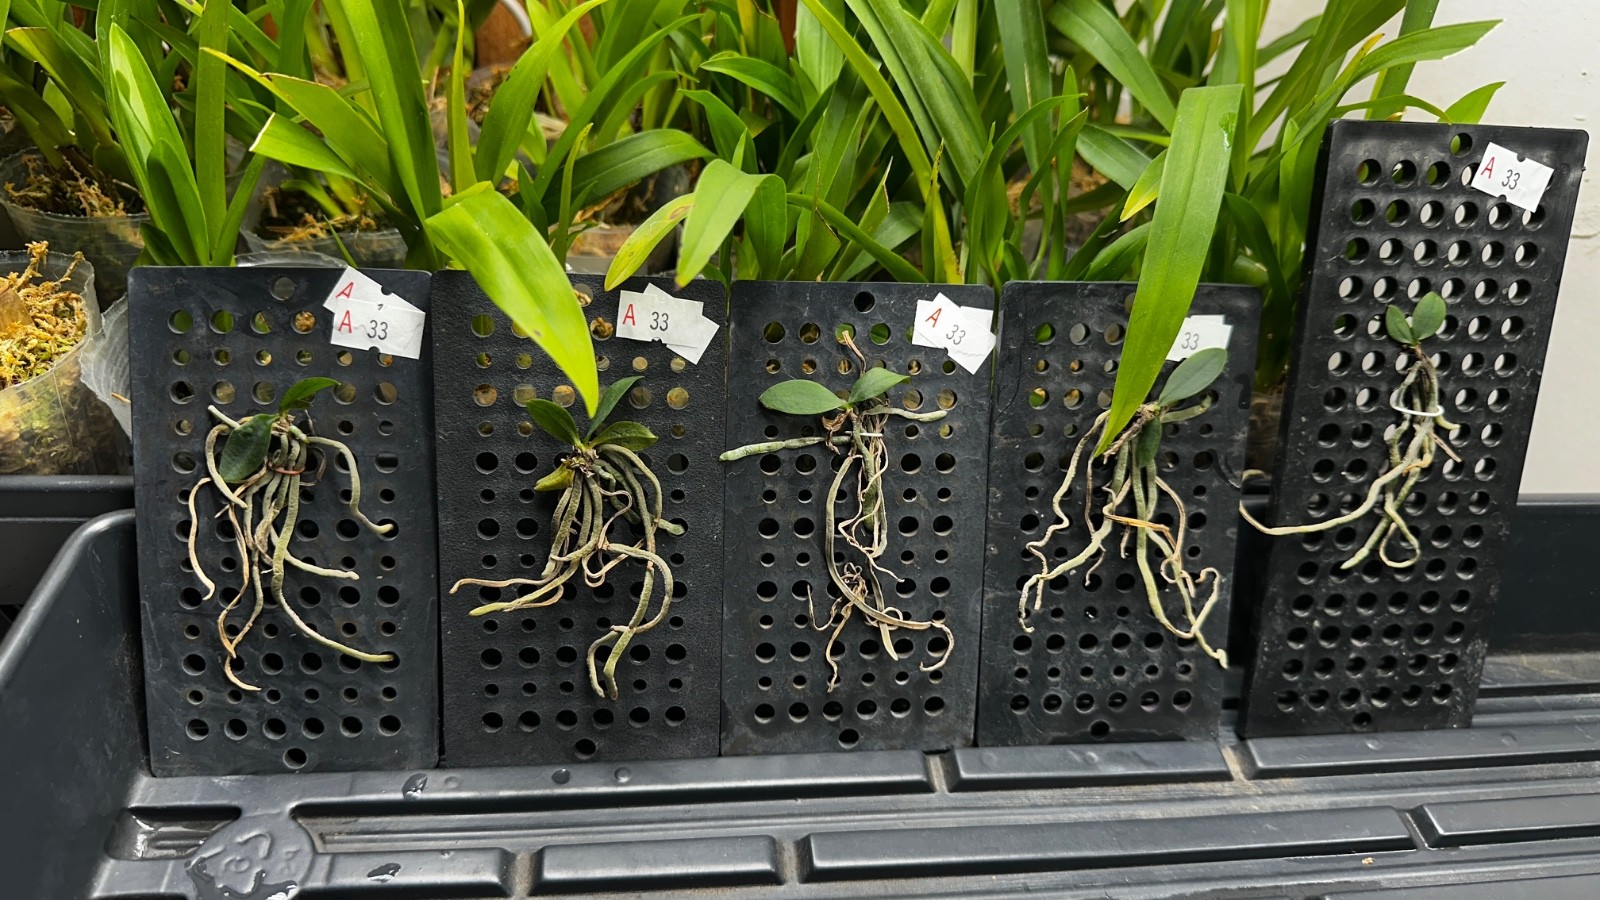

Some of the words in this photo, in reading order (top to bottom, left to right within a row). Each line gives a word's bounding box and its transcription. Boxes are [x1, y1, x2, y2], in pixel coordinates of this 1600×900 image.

[1481, 157, 1495, 179] A
[1502, 169, 1520, 190] 33
[336, 282, 354, 298] A
[338, 310, 352, 333] A
[367, 320, 388, 340] 33
[622, 304, 636, 326] A
[650, 312, 669, 331] 33
[925, 308, 942, 328] A
[946, 325, 966, 345] 33
[1181, 332, 1200, 350] 33
